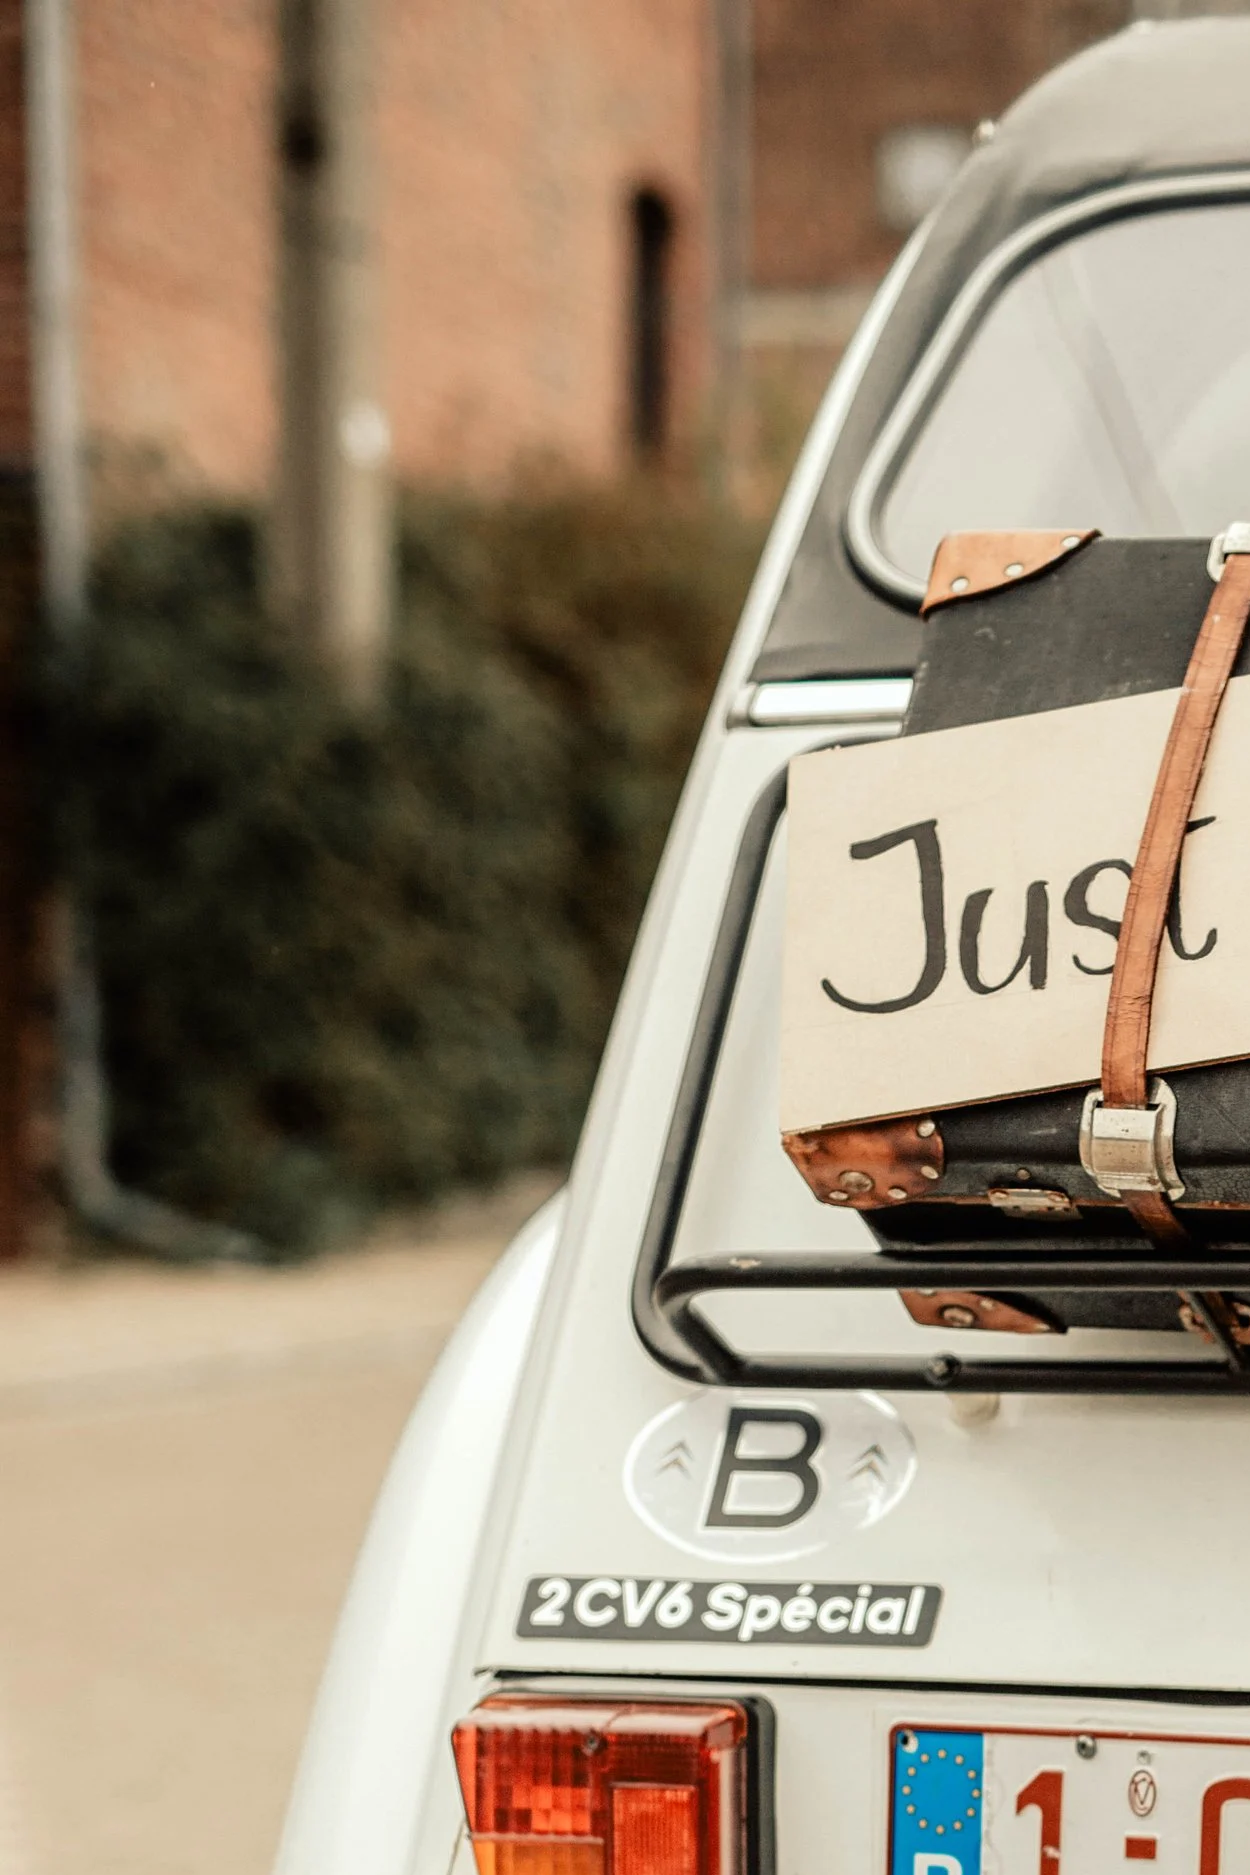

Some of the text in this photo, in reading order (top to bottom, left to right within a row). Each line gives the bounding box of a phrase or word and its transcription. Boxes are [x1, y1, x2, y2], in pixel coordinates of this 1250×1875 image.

[821, 818, 1218, 1014] Just
[704, 1407, 824, 1528] B
[529, 1577, 926, 1641] 2CV6 Spécial
